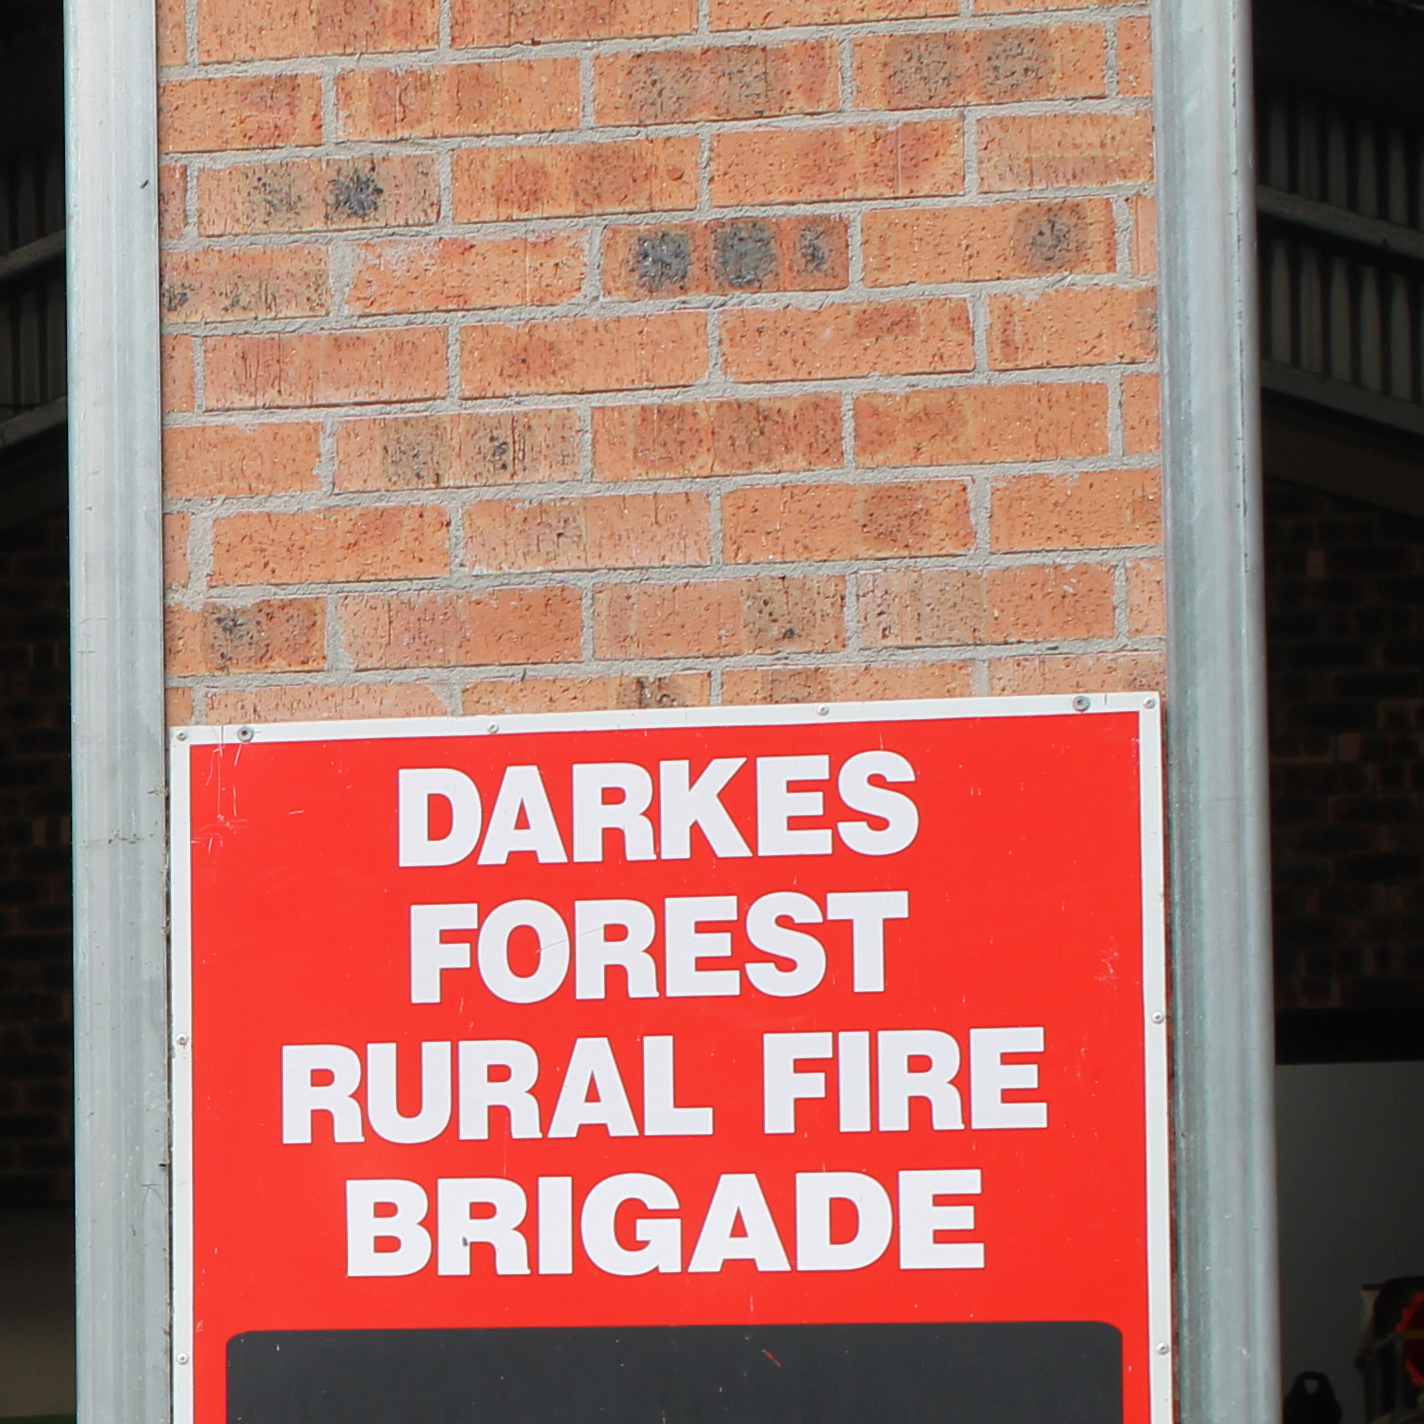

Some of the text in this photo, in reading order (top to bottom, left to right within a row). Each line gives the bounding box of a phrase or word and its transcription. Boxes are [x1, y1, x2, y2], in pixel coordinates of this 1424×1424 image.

[397, 750, 919, 868] DARKES
[408, 889, 910, 1005] FOREST
[281, 1026, 1049, 1145] RURAL FIRE
[345, 1168, 986, 1279] BRIGADE
